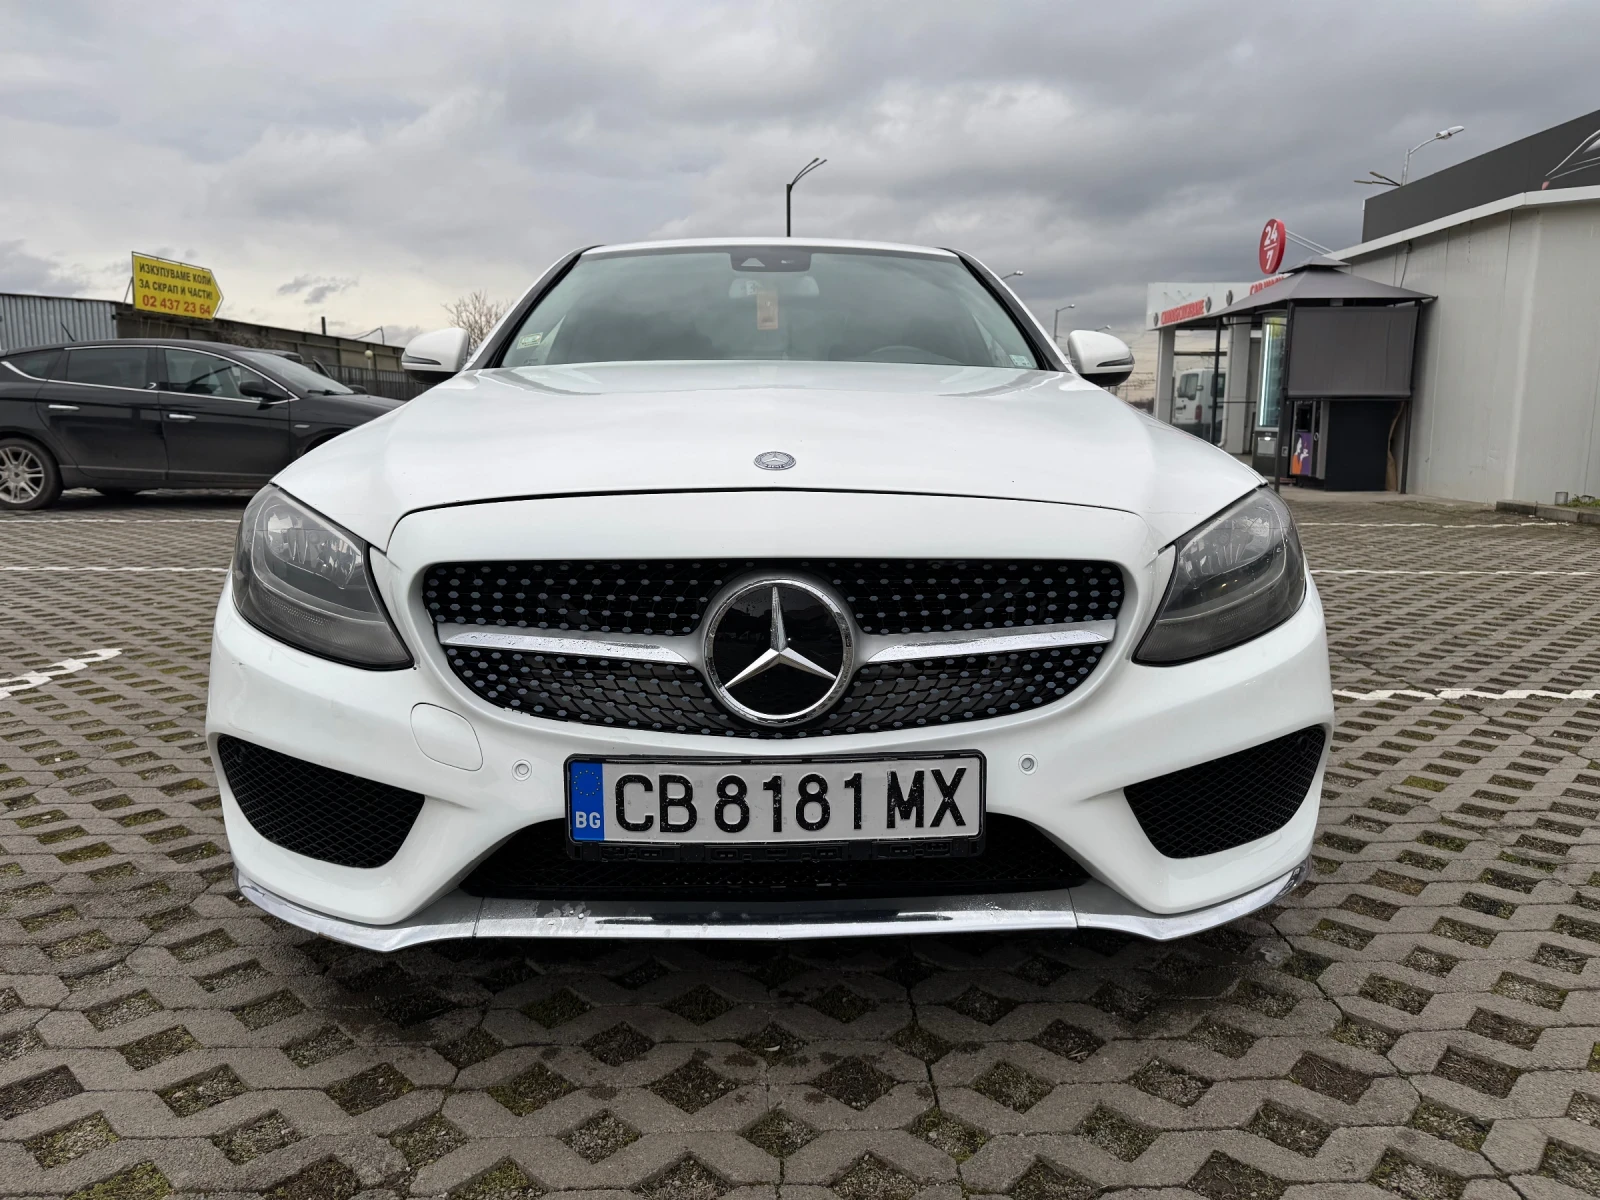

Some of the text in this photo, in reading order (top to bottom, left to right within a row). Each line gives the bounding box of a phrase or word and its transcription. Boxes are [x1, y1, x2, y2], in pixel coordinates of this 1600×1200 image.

[1264, 222, 1278, 246] 24
[1266, 249, 1274, 270] 7
[139, 262, 212, 286] ИЗКУПУВАМЕ КОЛИ
[139, 278, 213, 300] ЗА СКРАП И ЧАСТИ!
[142, 294, 211, 315] 02 437 23 64
[615, 767, 967, 833] CB 8181 MX
[575, 811, 601, 829] BG
